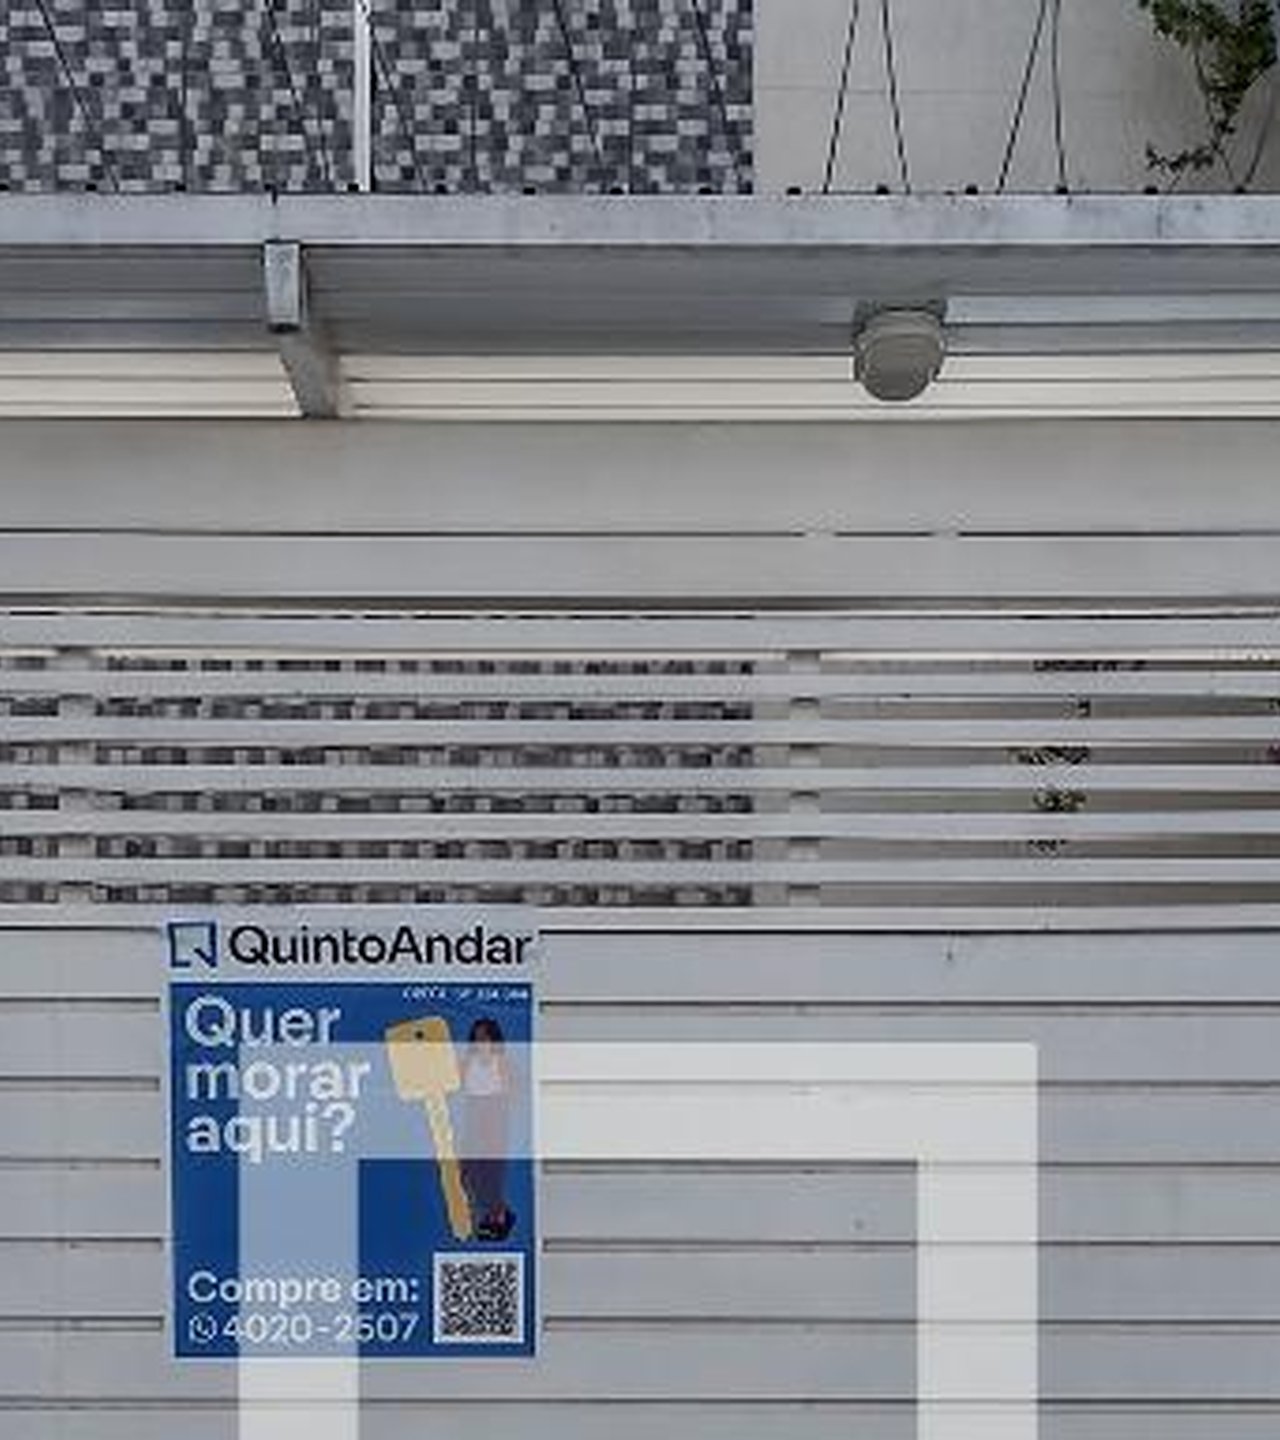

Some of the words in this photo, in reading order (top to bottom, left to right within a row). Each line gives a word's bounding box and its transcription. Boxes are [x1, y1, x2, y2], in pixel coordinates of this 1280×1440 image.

[228, 924, 534, 967] QuintoAndar
[185, 995, 342, 1047] Quer
[185, 1059, 371, 1100] morar
[185, 1102, 356, 1164] aqui?
[187, 1270, 342, 1309] Compre
[350, 1276, 420, 1303] em:
[221, 1312, 420, 1344] 4020-2507
